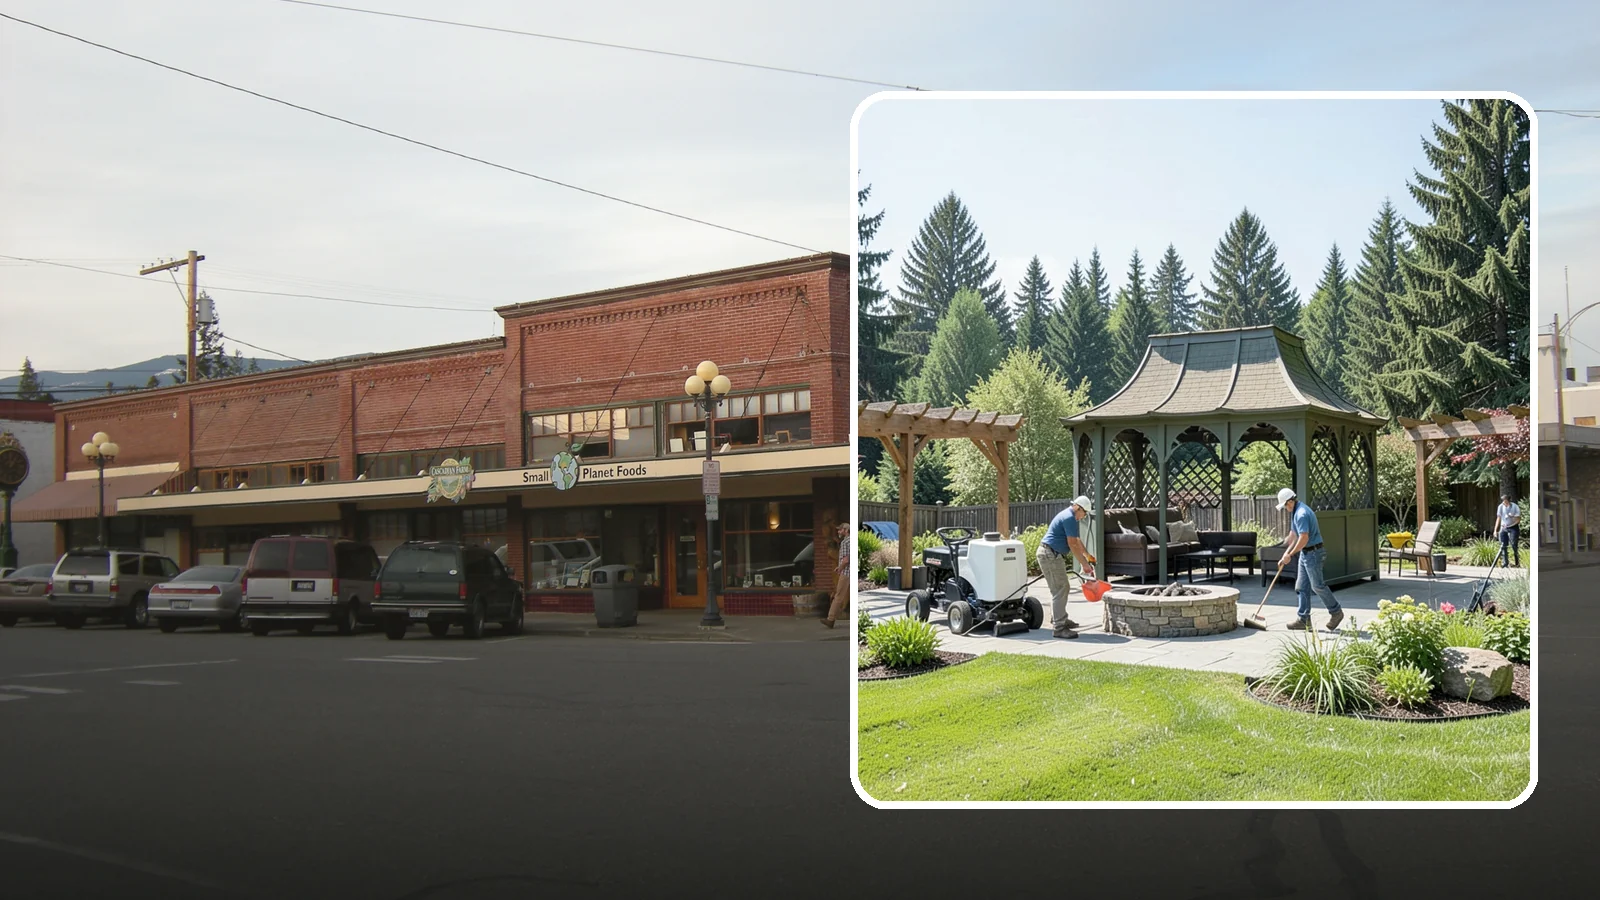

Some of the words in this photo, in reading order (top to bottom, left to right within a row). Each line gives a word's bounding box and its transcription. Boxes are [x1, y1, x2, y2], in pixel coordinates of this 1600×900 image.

[523, 471, 549, 482] Small
[583, 467, 614, 479] Planet
[617, 464, 647, 477] Foods
